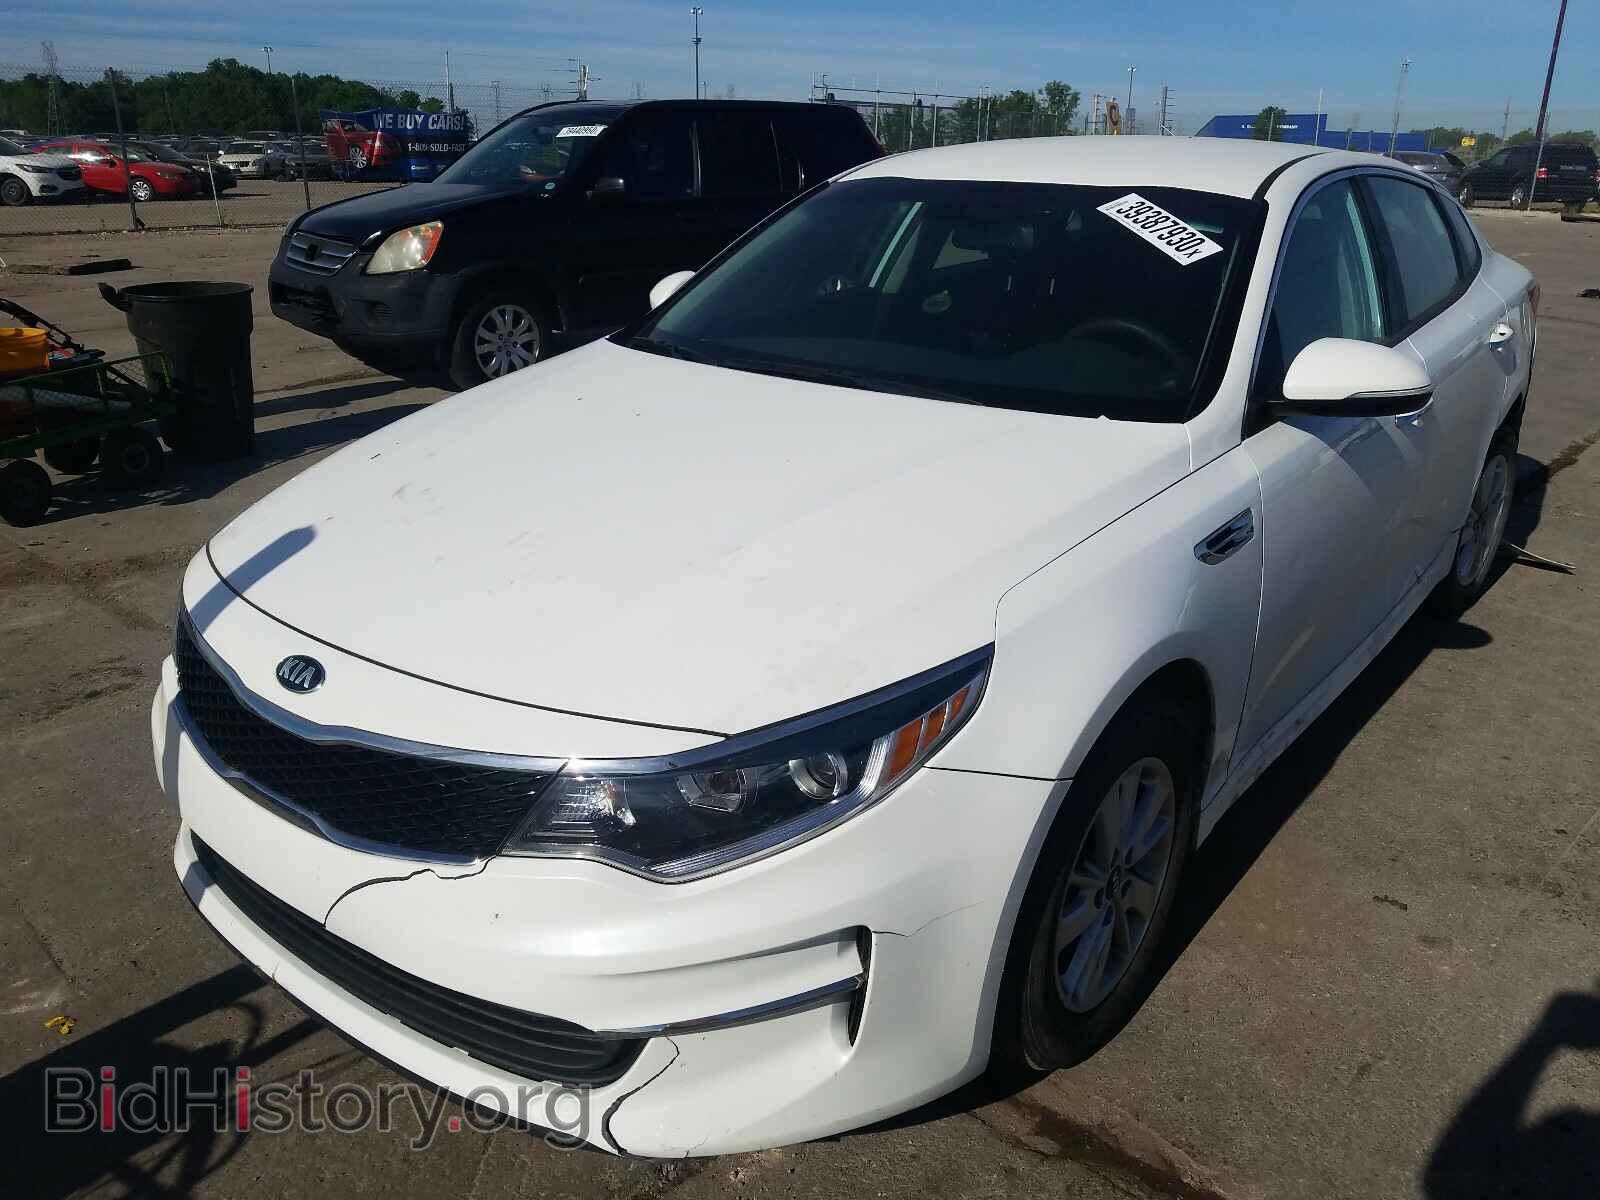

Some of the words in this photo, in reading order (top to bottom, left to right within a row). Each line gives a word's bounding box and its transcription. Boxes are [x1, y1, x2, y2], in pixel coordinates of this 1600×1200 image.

[373, 113, 393, 129] WE
[398, 114, 425, 129] BUY
[428, 114, 464, 130] CARS!
[1116, 201, 1206, 253] 39387930
[278, 653, 315, 688] KIA
